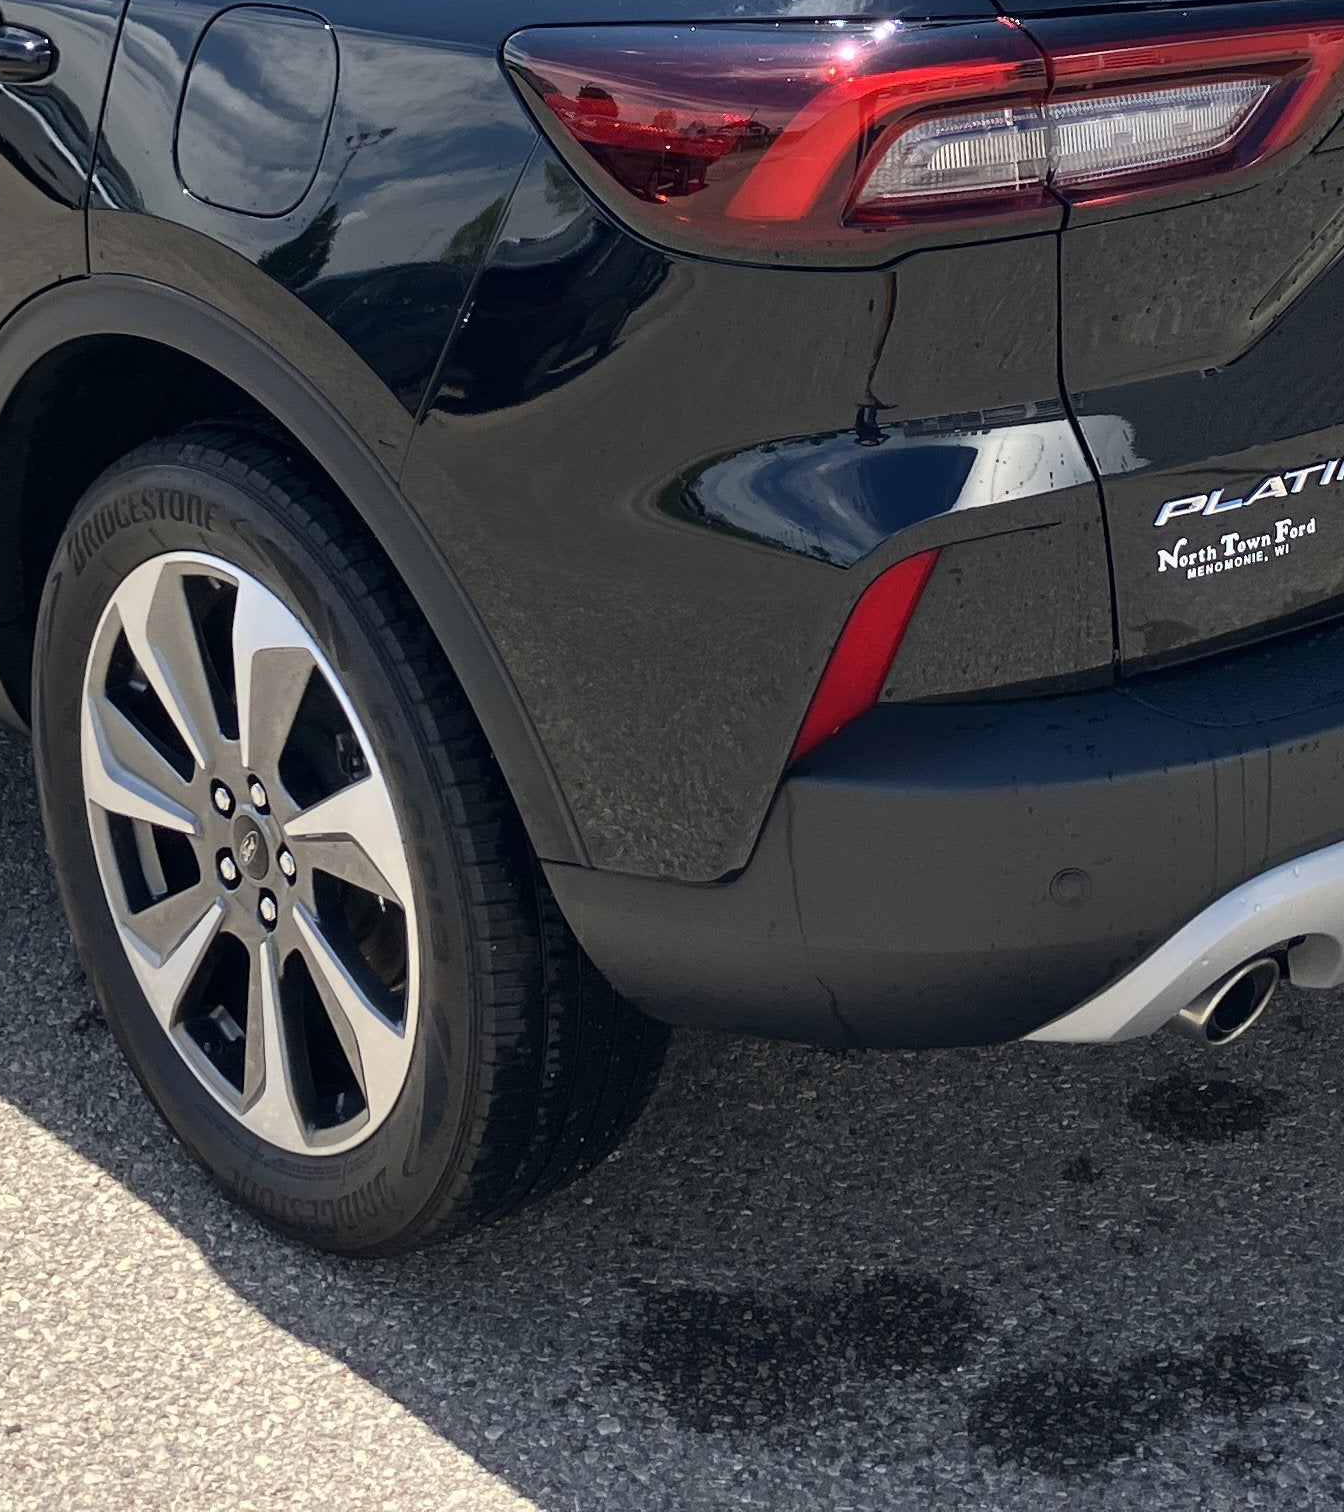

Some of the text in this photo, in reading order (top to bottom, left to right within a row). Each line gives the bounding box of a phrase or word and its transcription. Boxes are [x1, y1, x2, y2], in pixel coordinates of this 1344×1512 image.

[67, 488, 218, 577] BRIDGESTONE
[1157, 518, 1316, 572] North Town Ford
[1274, 543, 1289, 557] WI
